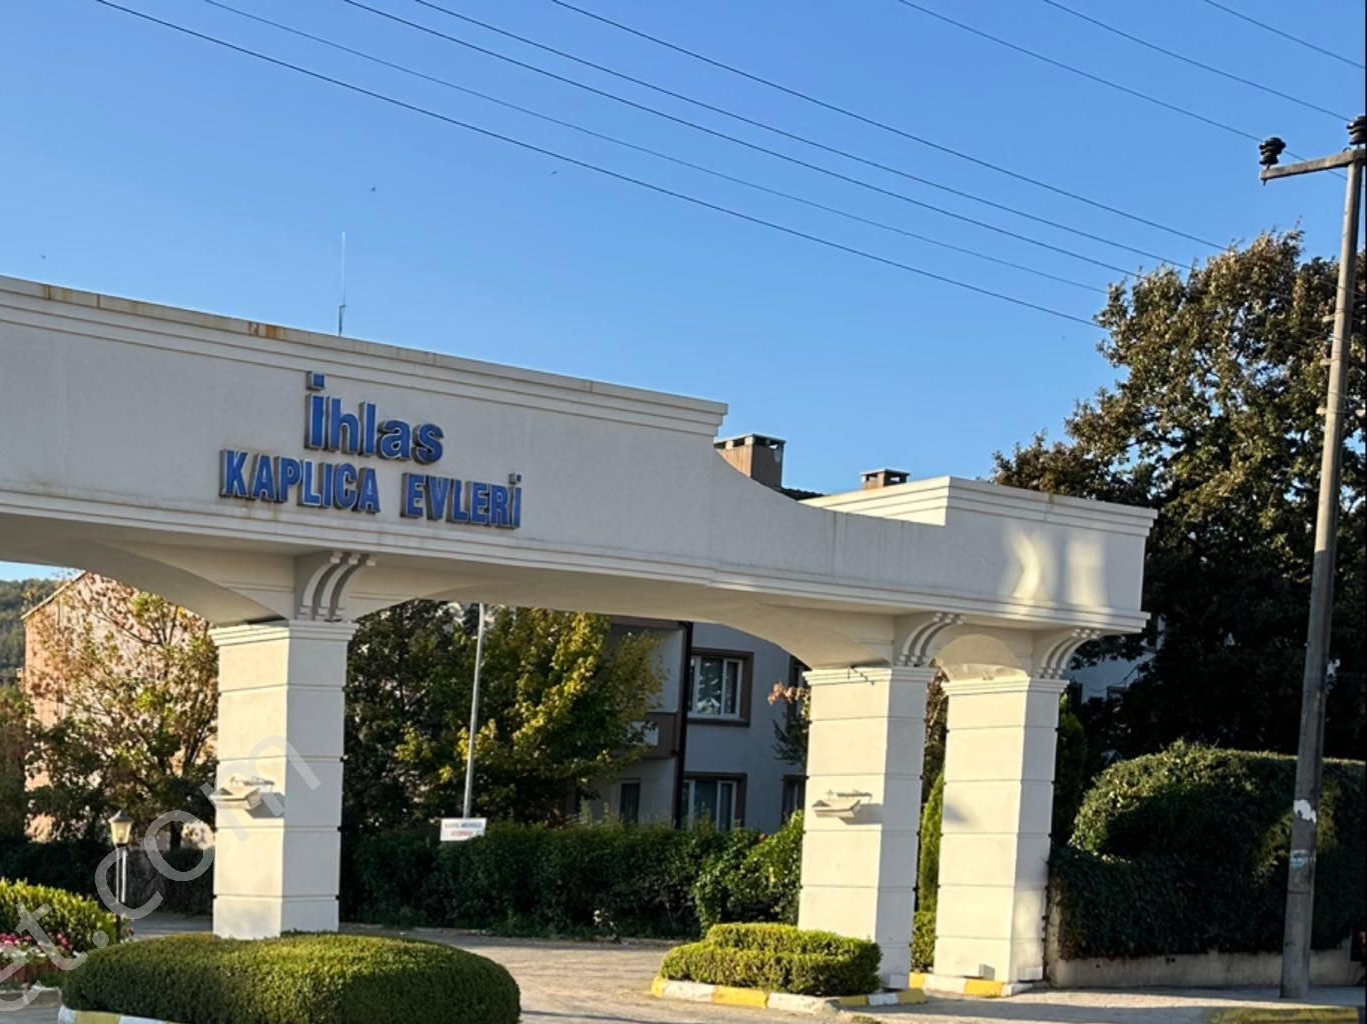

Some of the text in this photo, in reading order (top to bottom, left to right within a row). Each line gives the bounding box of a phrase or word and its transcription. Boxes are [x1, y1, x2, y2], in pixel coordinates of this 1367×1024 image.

[304, 370, 444, 464] İhlas
[219, 448, 522, 529] KAPLICA EVLERİ
